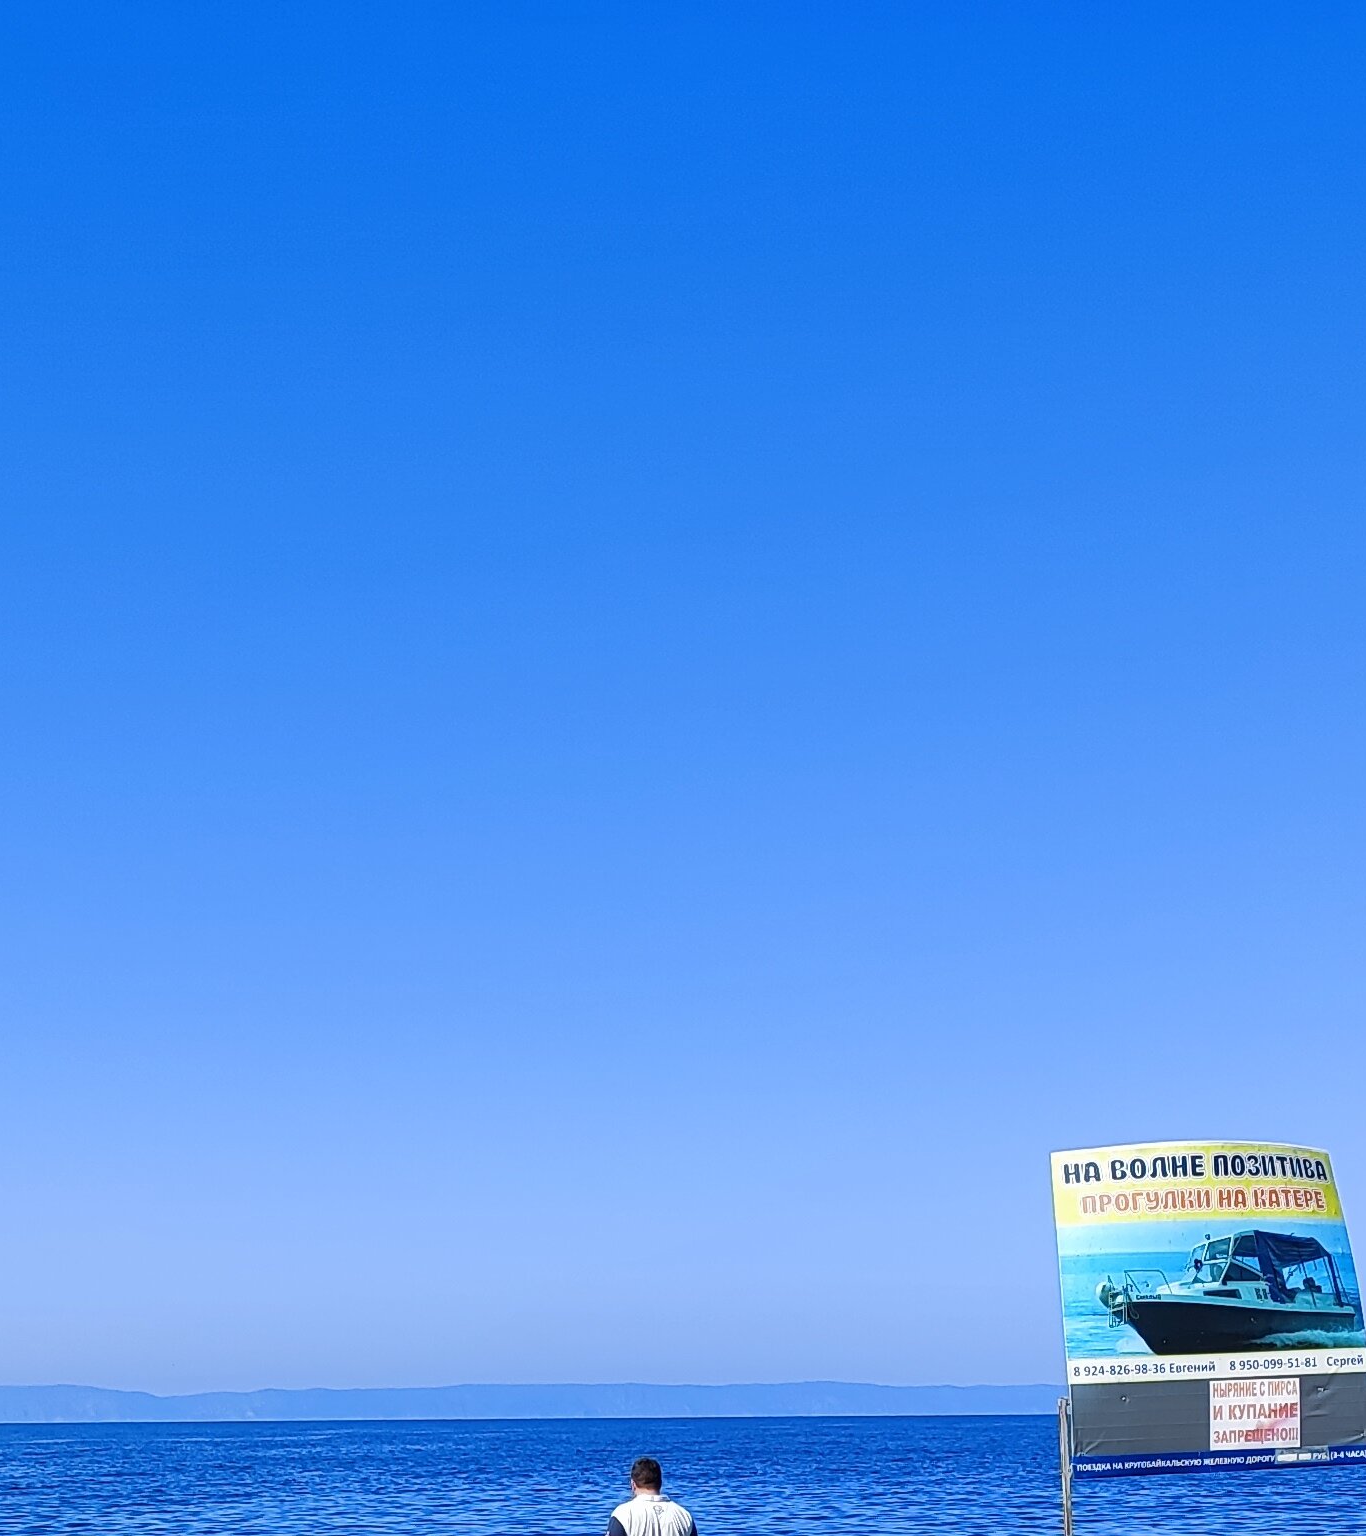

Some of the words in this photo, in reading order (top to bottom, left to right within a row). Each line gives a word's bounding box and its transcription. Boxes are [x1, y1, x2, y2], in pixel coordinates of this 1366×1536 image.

[1063, 1162, 1102, 1184] НА
[1110, 1155, 1205, 1180] ВОЛНЕ
[1213, 1154, 1328, 1180] ПОЗИТИВА
[1081, 1189, 1211, 1214] ПРОГУЛКИ
[1218, 1189, 1247, 1209] НА
[1253, 1189, 1325, 1209] КАТЕРЕ
[1073, 1366, 1081, 1377] 8
[1084, 1363, 1166, 1376] 924-826-98-36
[1169, 1360, 1216, 1373] Евгений
[1229, 1360, 1236, 1371] 8
[1239, 1357, 1318, 1371] 950-099-51-81
[1326, 1354, 1364, 1368] Сергей
[1259, 1381, 1266, 1396] С
[1267, 1380, 1298, 1396] ПИРСА
[1213, 1405, 1223, 1420] И
[1228, 1402, 1299, 1420] КУПАНИЕ
[1112, 1462, 1123, 1470] НА
